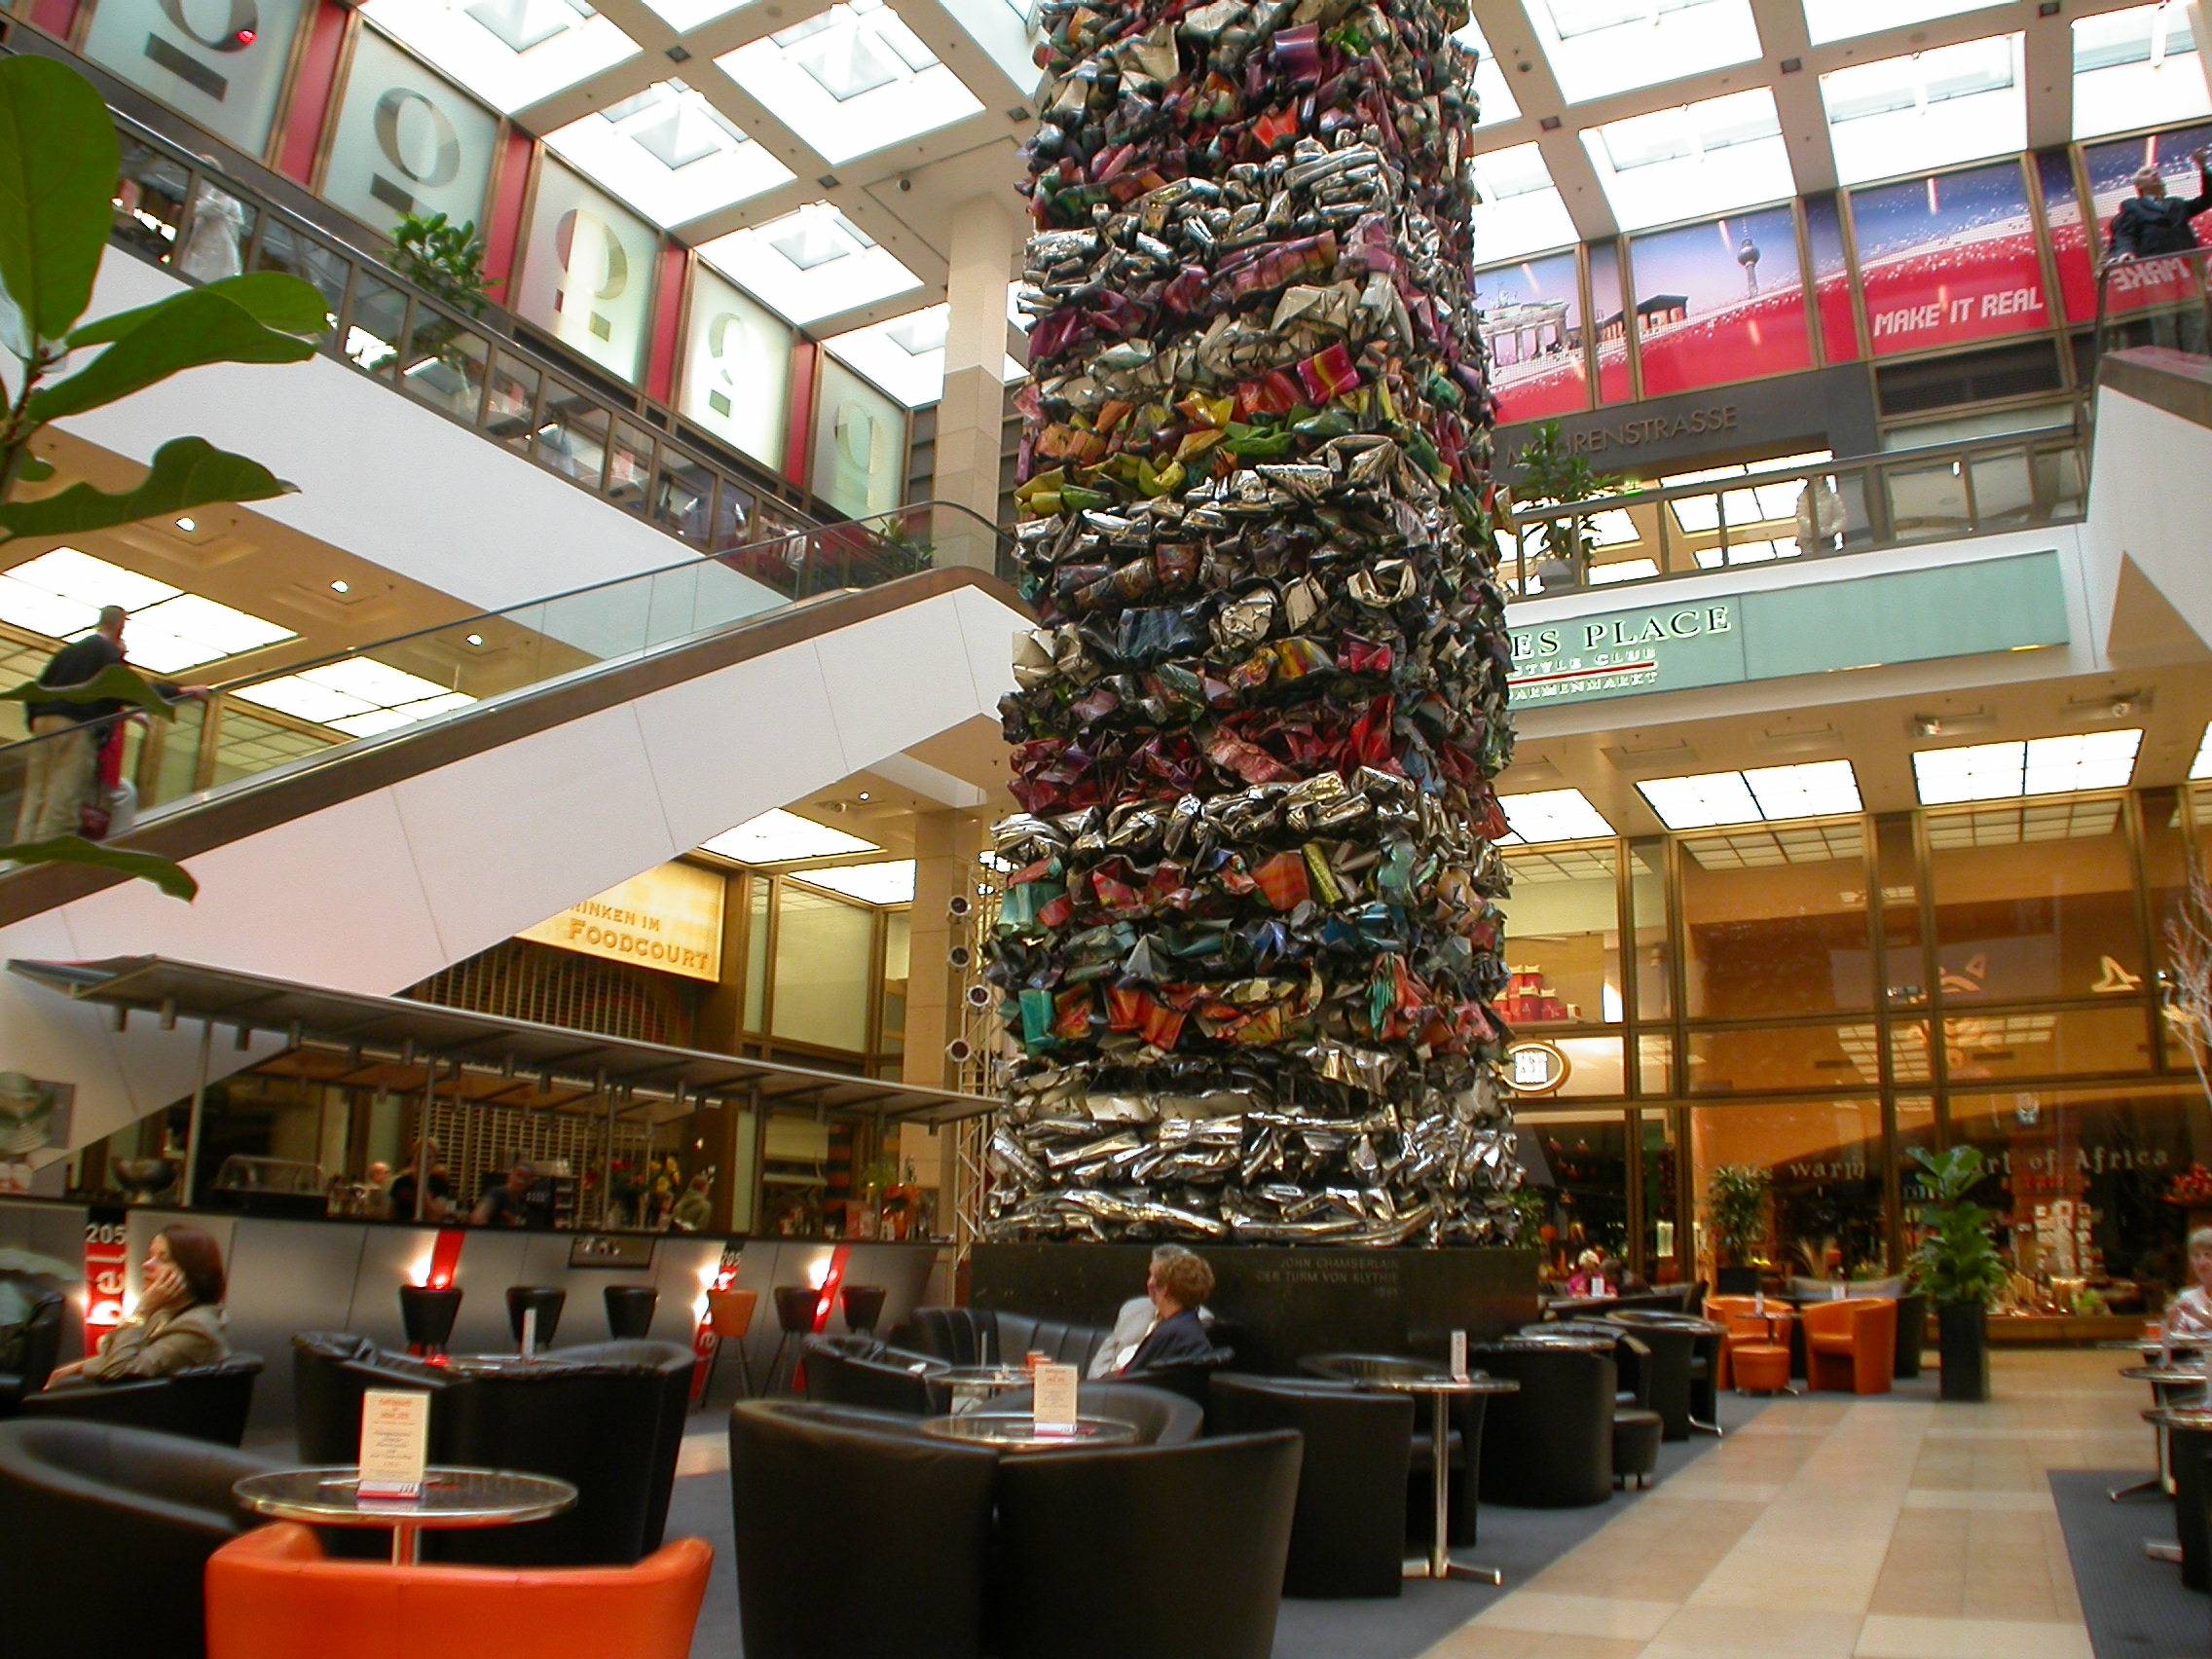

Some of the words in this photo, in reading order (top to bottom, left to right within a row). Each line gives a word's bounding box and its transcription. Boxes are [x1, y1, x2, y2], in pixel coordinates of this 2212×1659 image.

[1873, 304, 1939, 336] MAKE
[1950, 297, 1974, 323] IT
[1981, 287, 2044, 318] REAL
[1584, 606, 1731, 651] PLACE
[569, 918, 709, 970] FOODCOURT
[2076, 1146, 2168, 1174] Africa
[85, 1223, 126, 1245] 205
